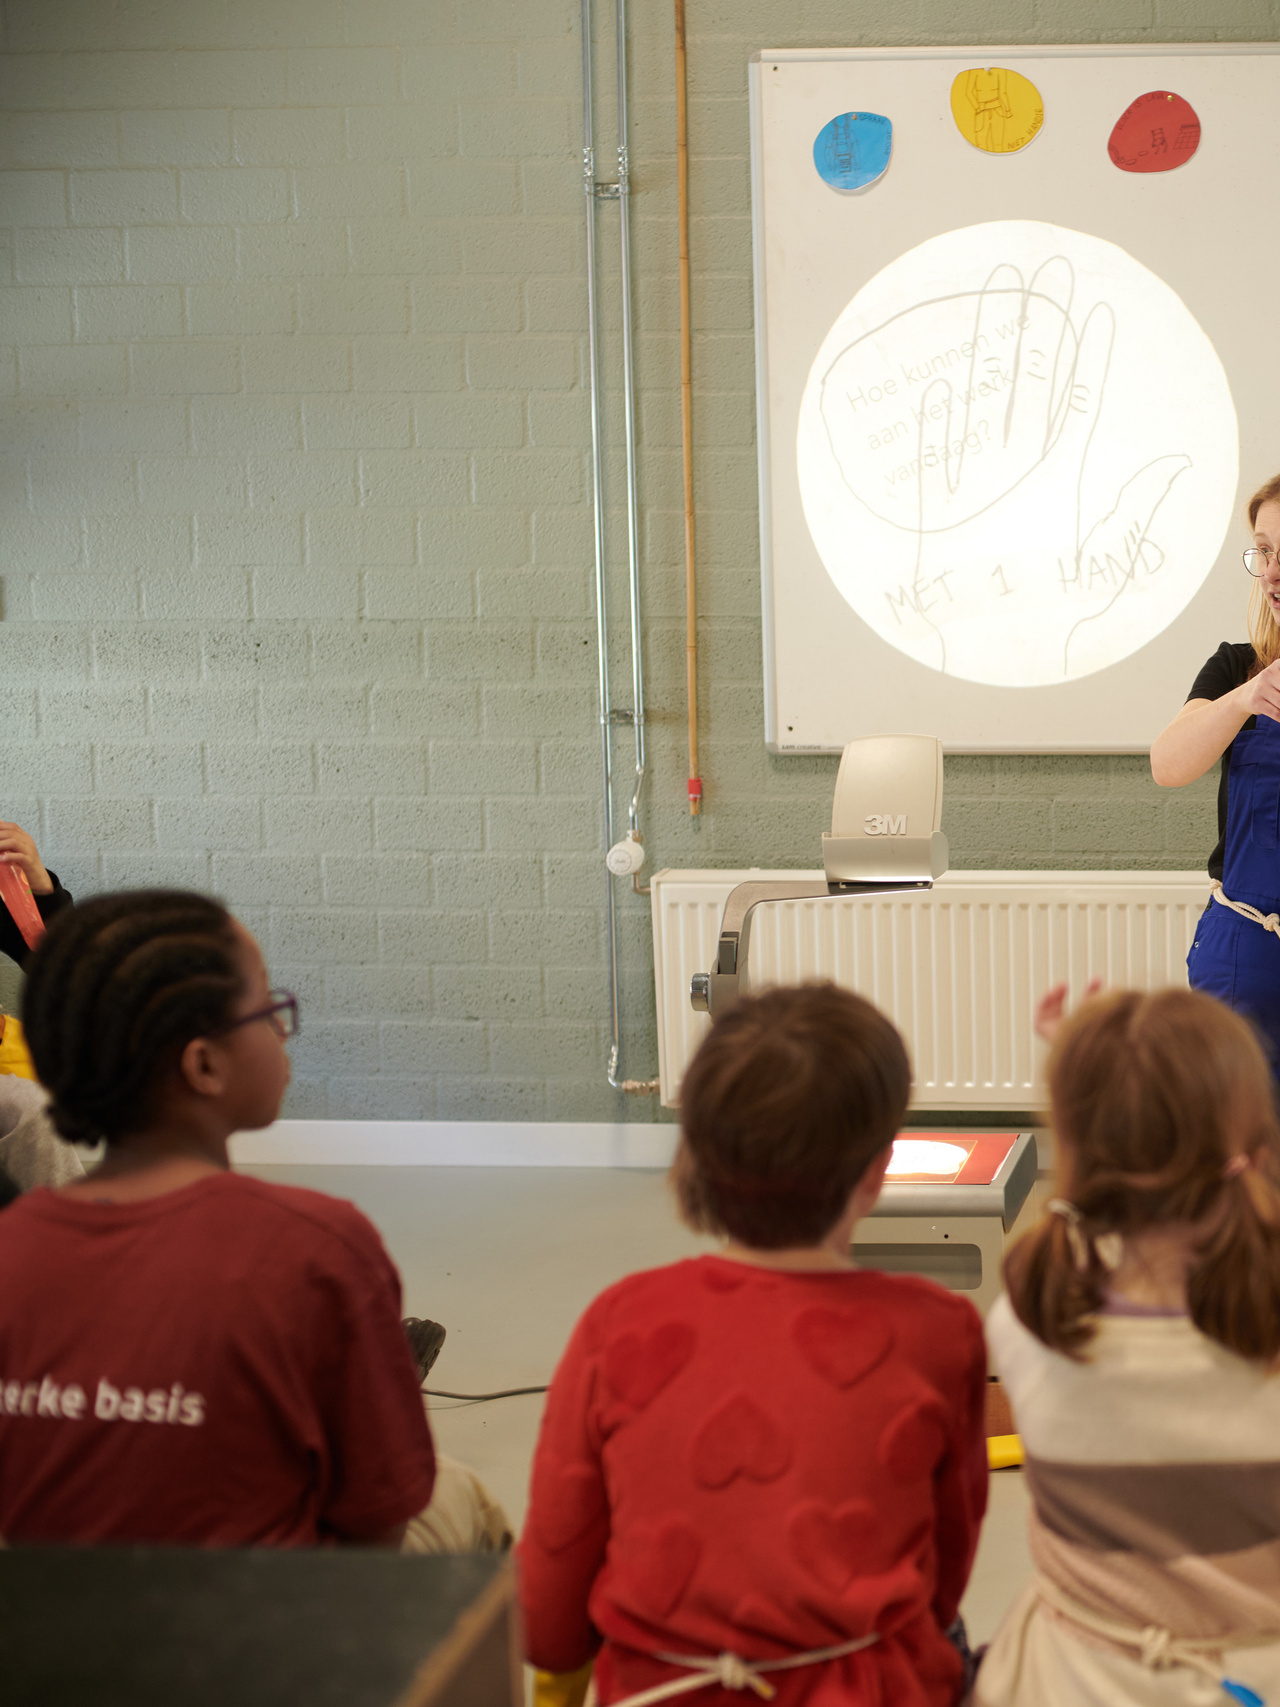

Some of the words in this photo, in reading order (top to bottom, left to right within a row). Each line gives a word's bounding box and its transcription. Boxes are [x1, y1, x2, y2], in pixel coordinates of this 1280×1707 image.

[846, 379, 898, 412] Hoe
[900, 334, 990, 386] kunnen
[995, 315, 1031, 340] we
[867, 421, 909, 450] aan
[910, 397, 954, 425] het
[957, 365, 1015, 406] werk
[883, 419, 991, 486] vandaag?
[884, 569, 954, 625] MET
[863, 814, 908, 836] 3M
[94, 1376, 206, 1427] basis
